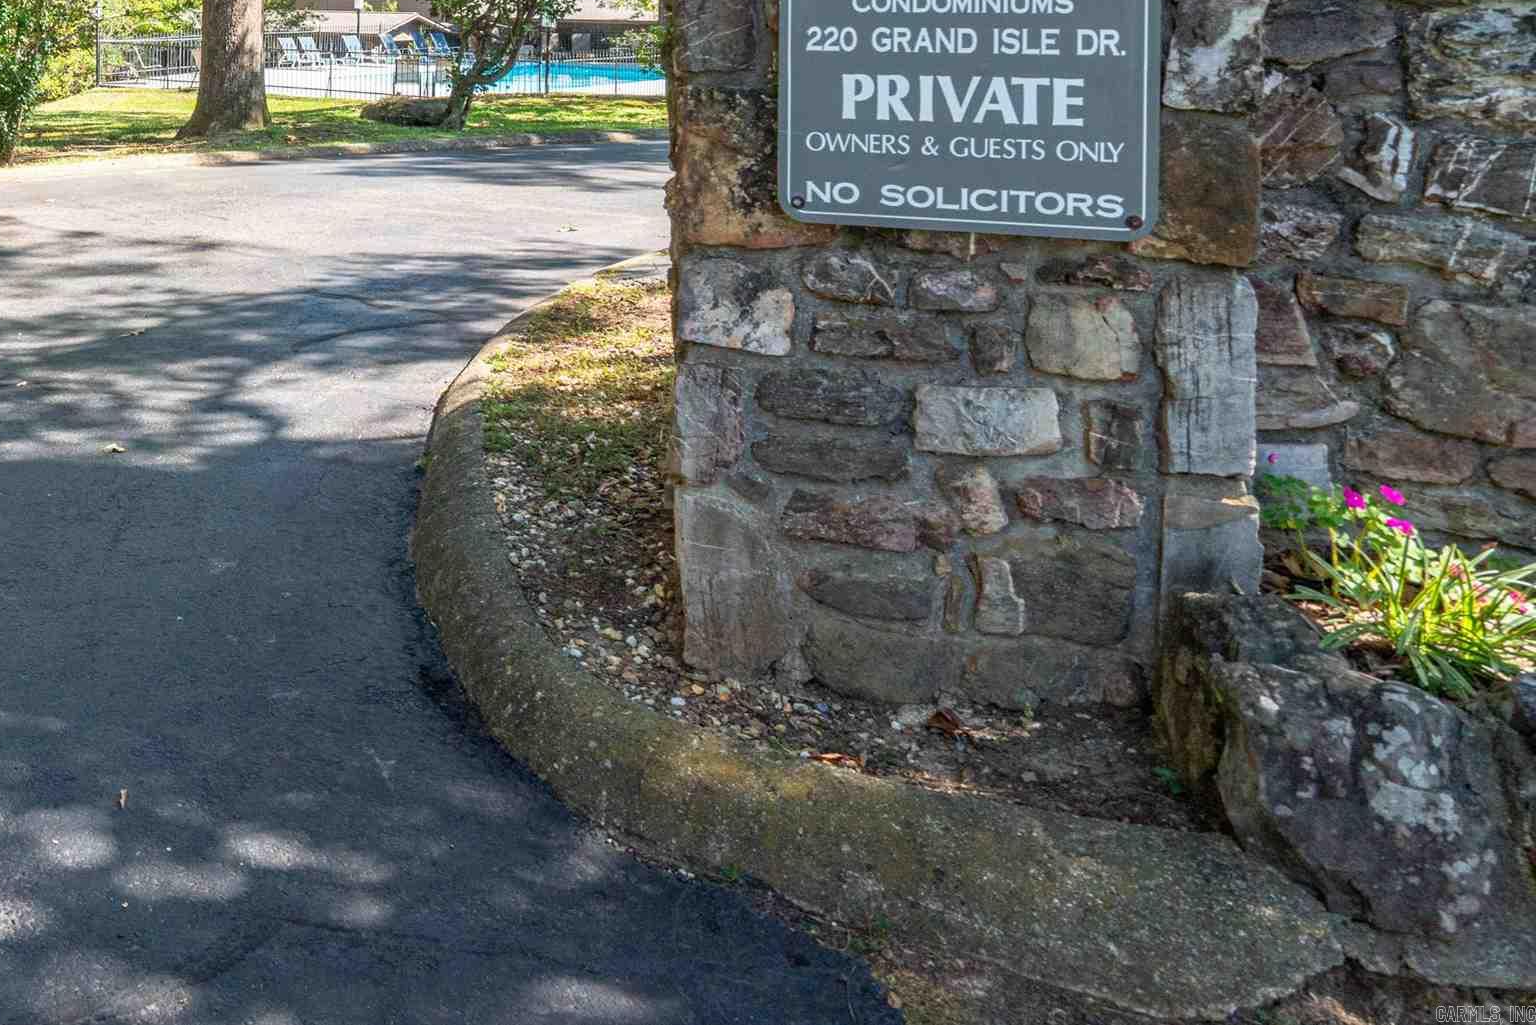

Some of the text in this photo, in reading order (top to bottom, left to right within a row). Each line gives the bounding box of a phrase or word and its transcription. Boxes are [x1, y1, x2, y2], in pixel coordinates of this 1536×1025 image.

[805, 27, 1127, 56] 220 GRAND ISLE DR.
[841, 74, 1086, 127] PRIVATE
[805, 131, 1125, 163] OWNERS & GUESTS ONLY
[804, 181, 1124, 218] NO SOLICITORS
